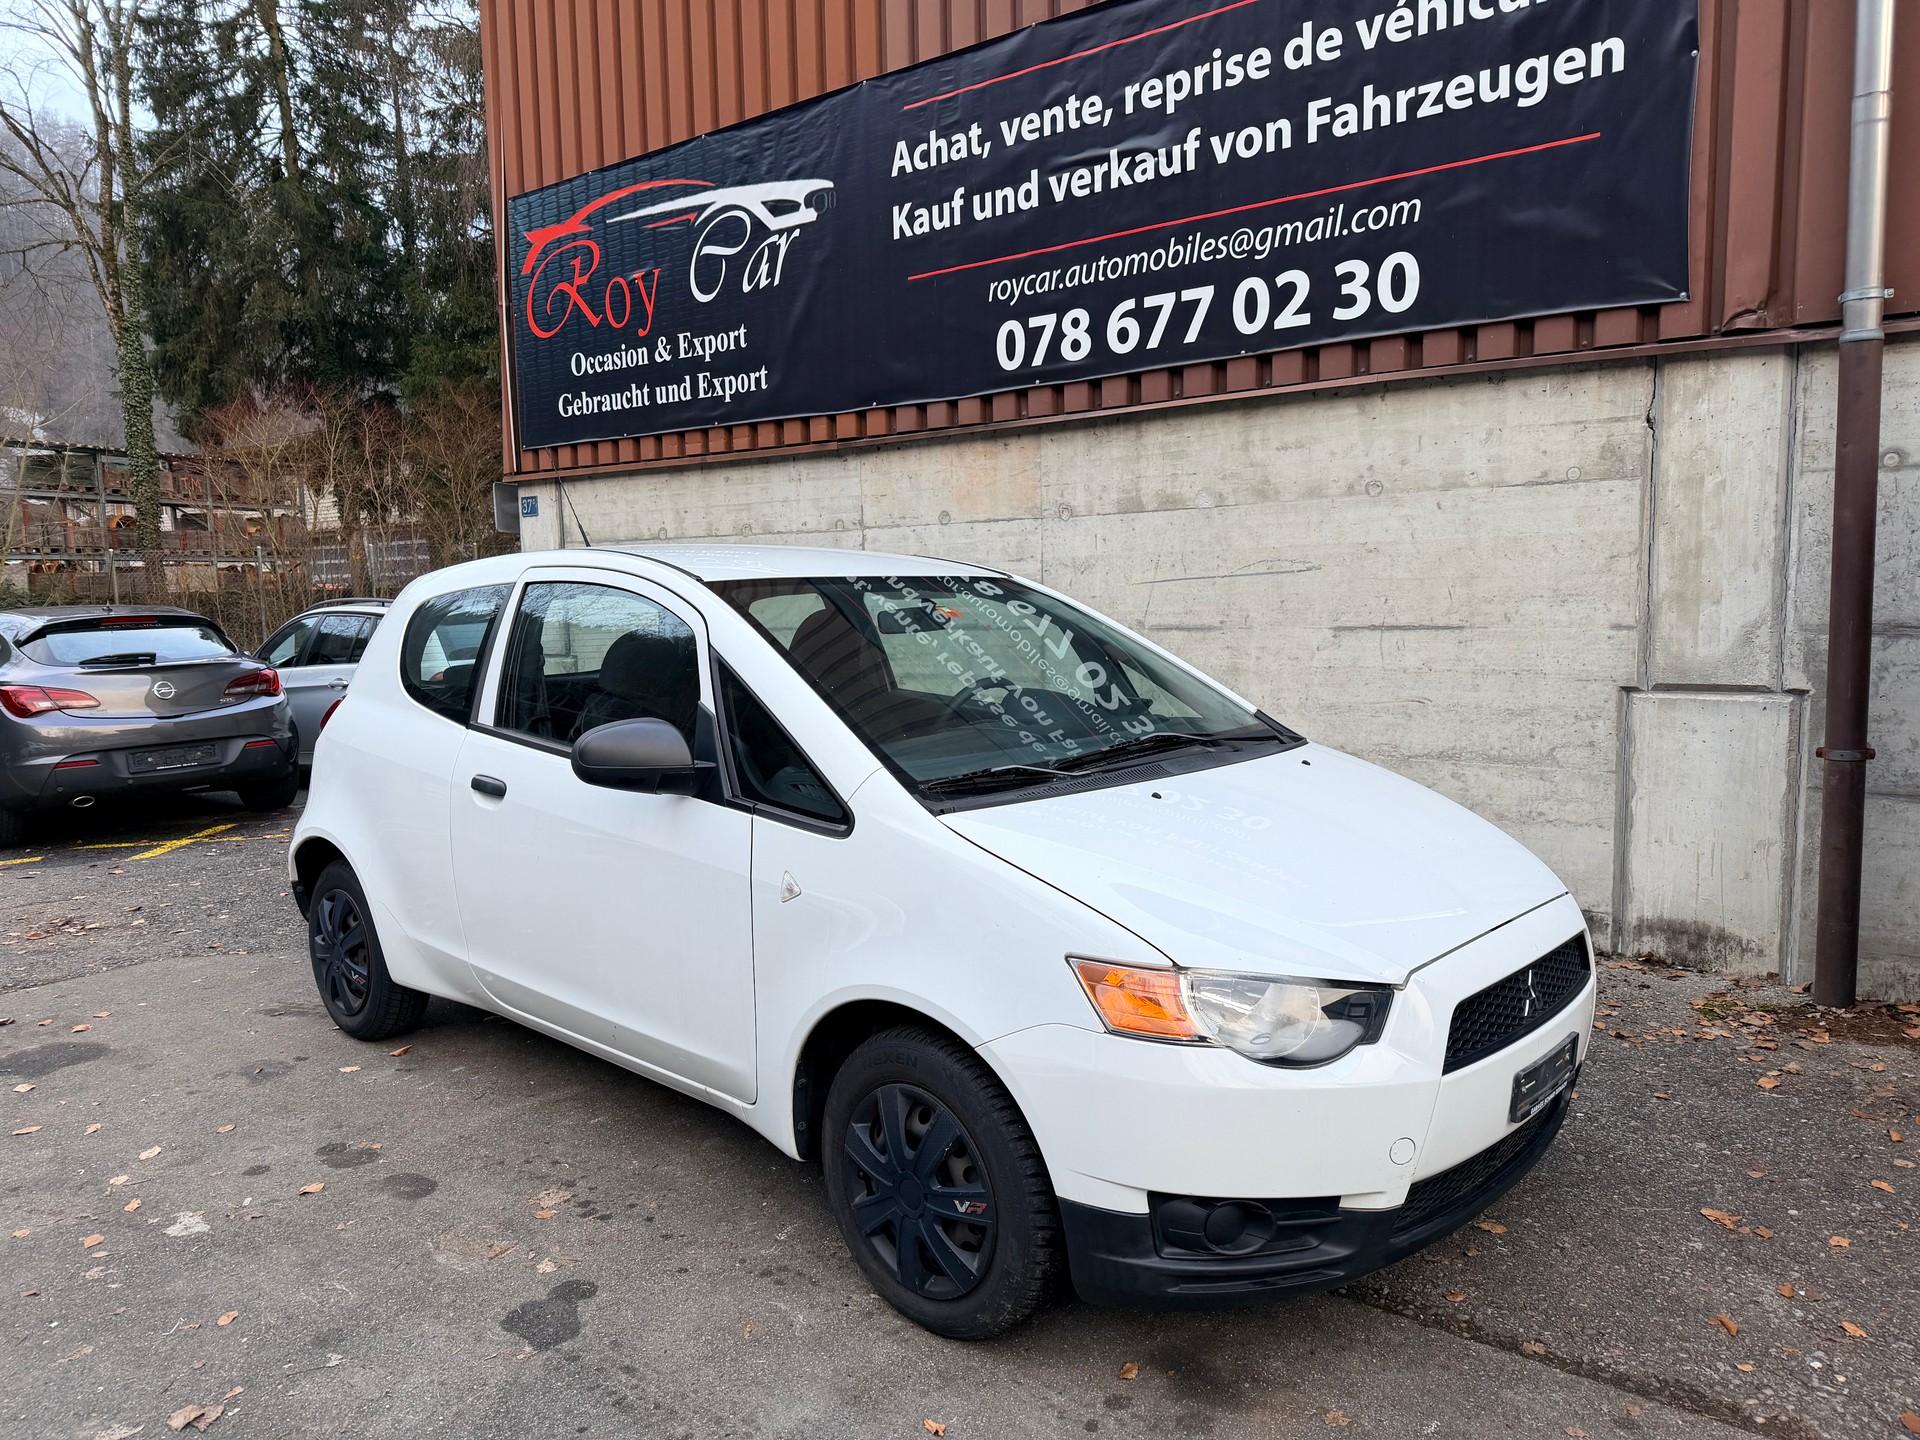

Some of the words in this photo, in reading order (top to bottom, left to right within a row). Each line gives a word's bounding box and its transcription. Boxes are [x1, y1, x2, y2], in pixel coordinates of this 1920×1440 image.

[891, 121, 992, 178] Achat,
[1000, 94, 1114, 148] vente,
[1124, 47, 1272, 116] reprise
[1283, 21, 1343, 70] de
[1355, 0, 1549, 51] véhic
[892, 187, 964, 240] Kauf
[972, 168, 1039, 222] und
[1049, 127, 1202, 203] verkauf
[1210, 116, 1292, 165] von
[1307, 36, 1626, 144] Fahrzeugen
[526, 239, 662, 339] Roy
[689, 209, 801, 303] Car
[988, 198, 1423, 307] roycar.automobiles@gmail.com
[996, 307, 1093, 372] 078
[1106, 284, 1216, 355] 677
[1232, 269, 1312, 336] 02
[1332, 251, 1421, 321] 30
[558, 383, 651, 418] Gebraucht
[655, 375, 692, 405] und
[697, 364, 769, 403] Export
[570, 343, 649, 377] Occasion
[654, 336, 672, 363] &
[678, 323, 748, 364] Export
